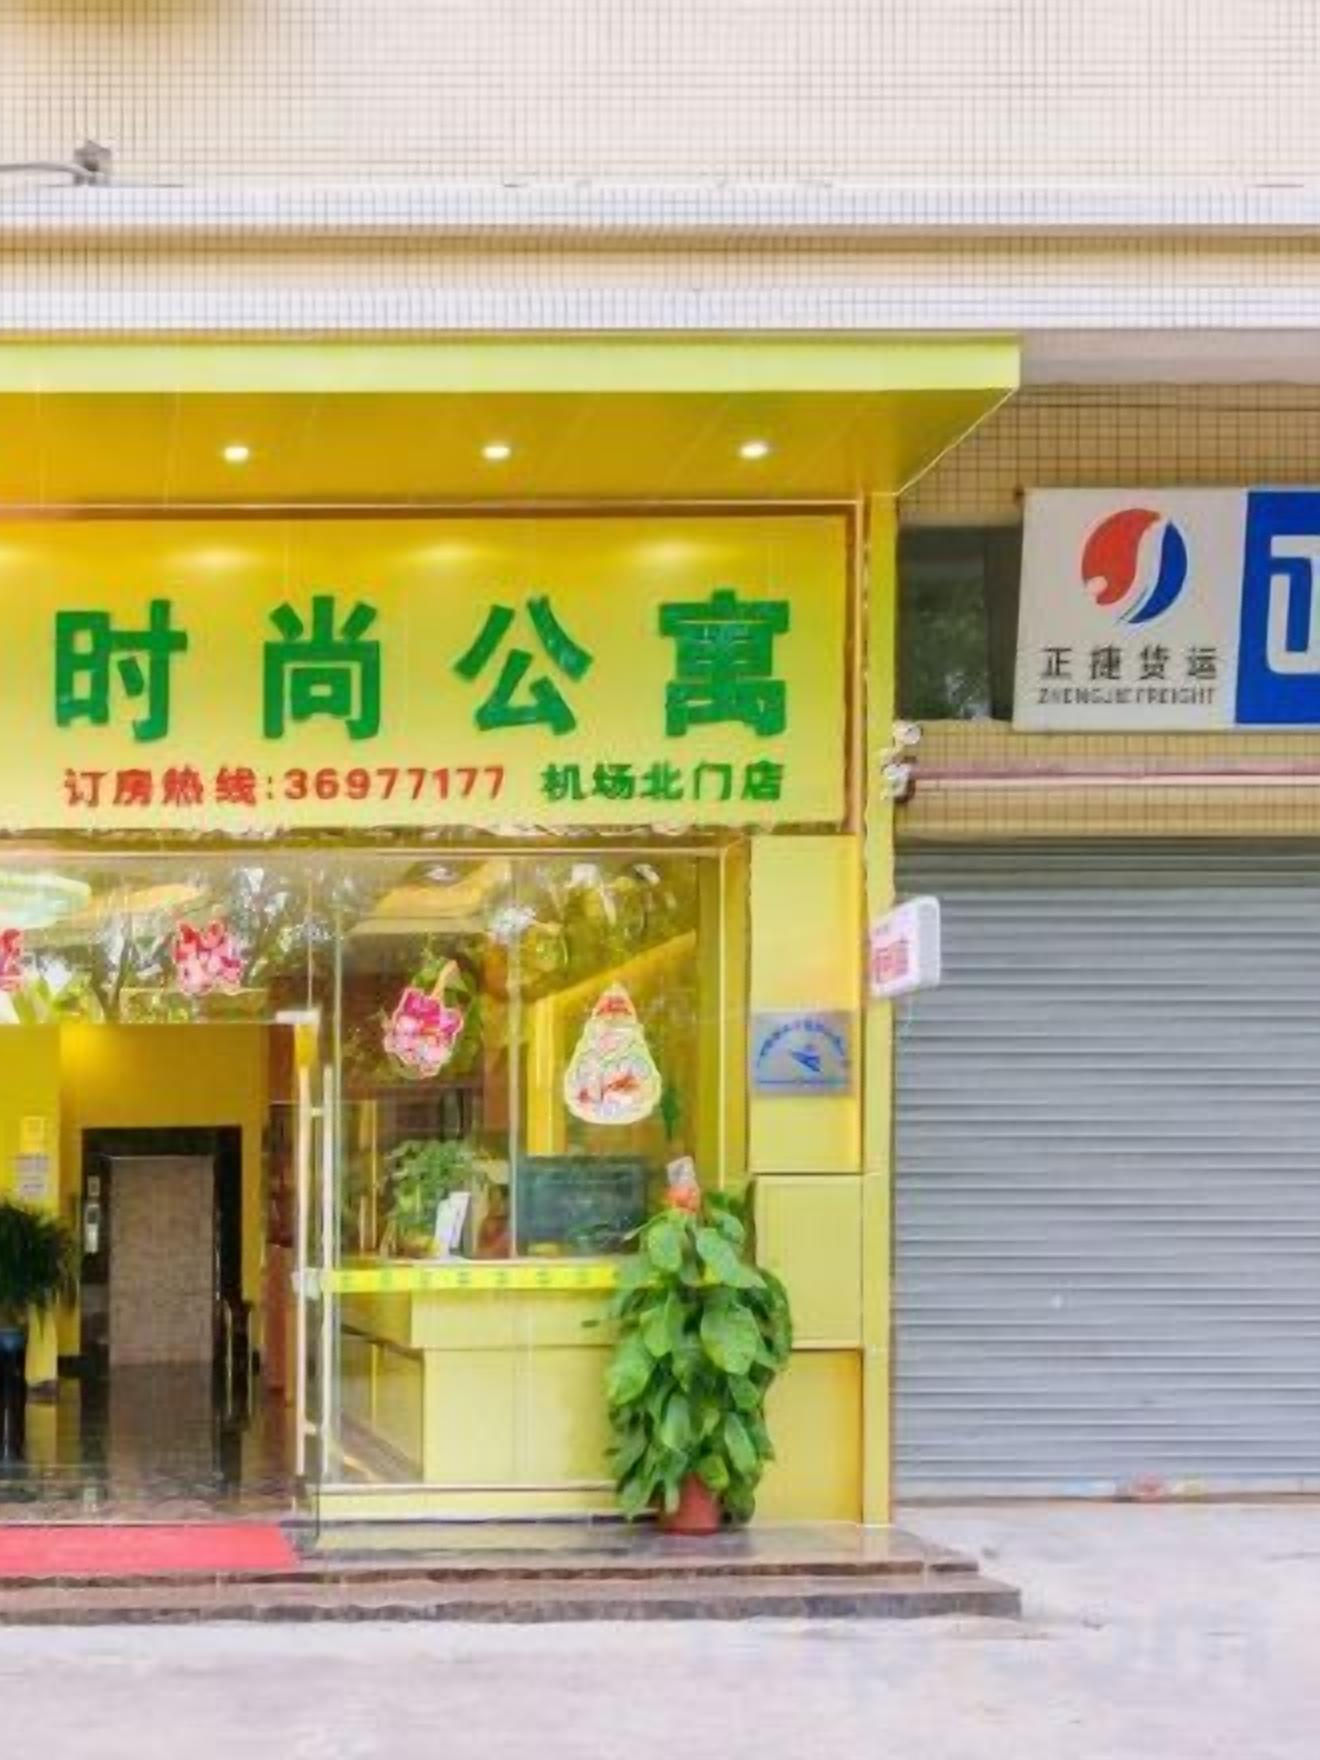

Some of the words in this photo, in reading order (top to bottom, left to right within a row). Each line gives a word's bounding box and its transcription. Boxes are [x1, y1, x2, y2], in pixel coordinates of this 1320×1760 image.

[63, 764, 505, 808] 订房热线:36977177
[539, 761, 787, 804] 机场北门店
